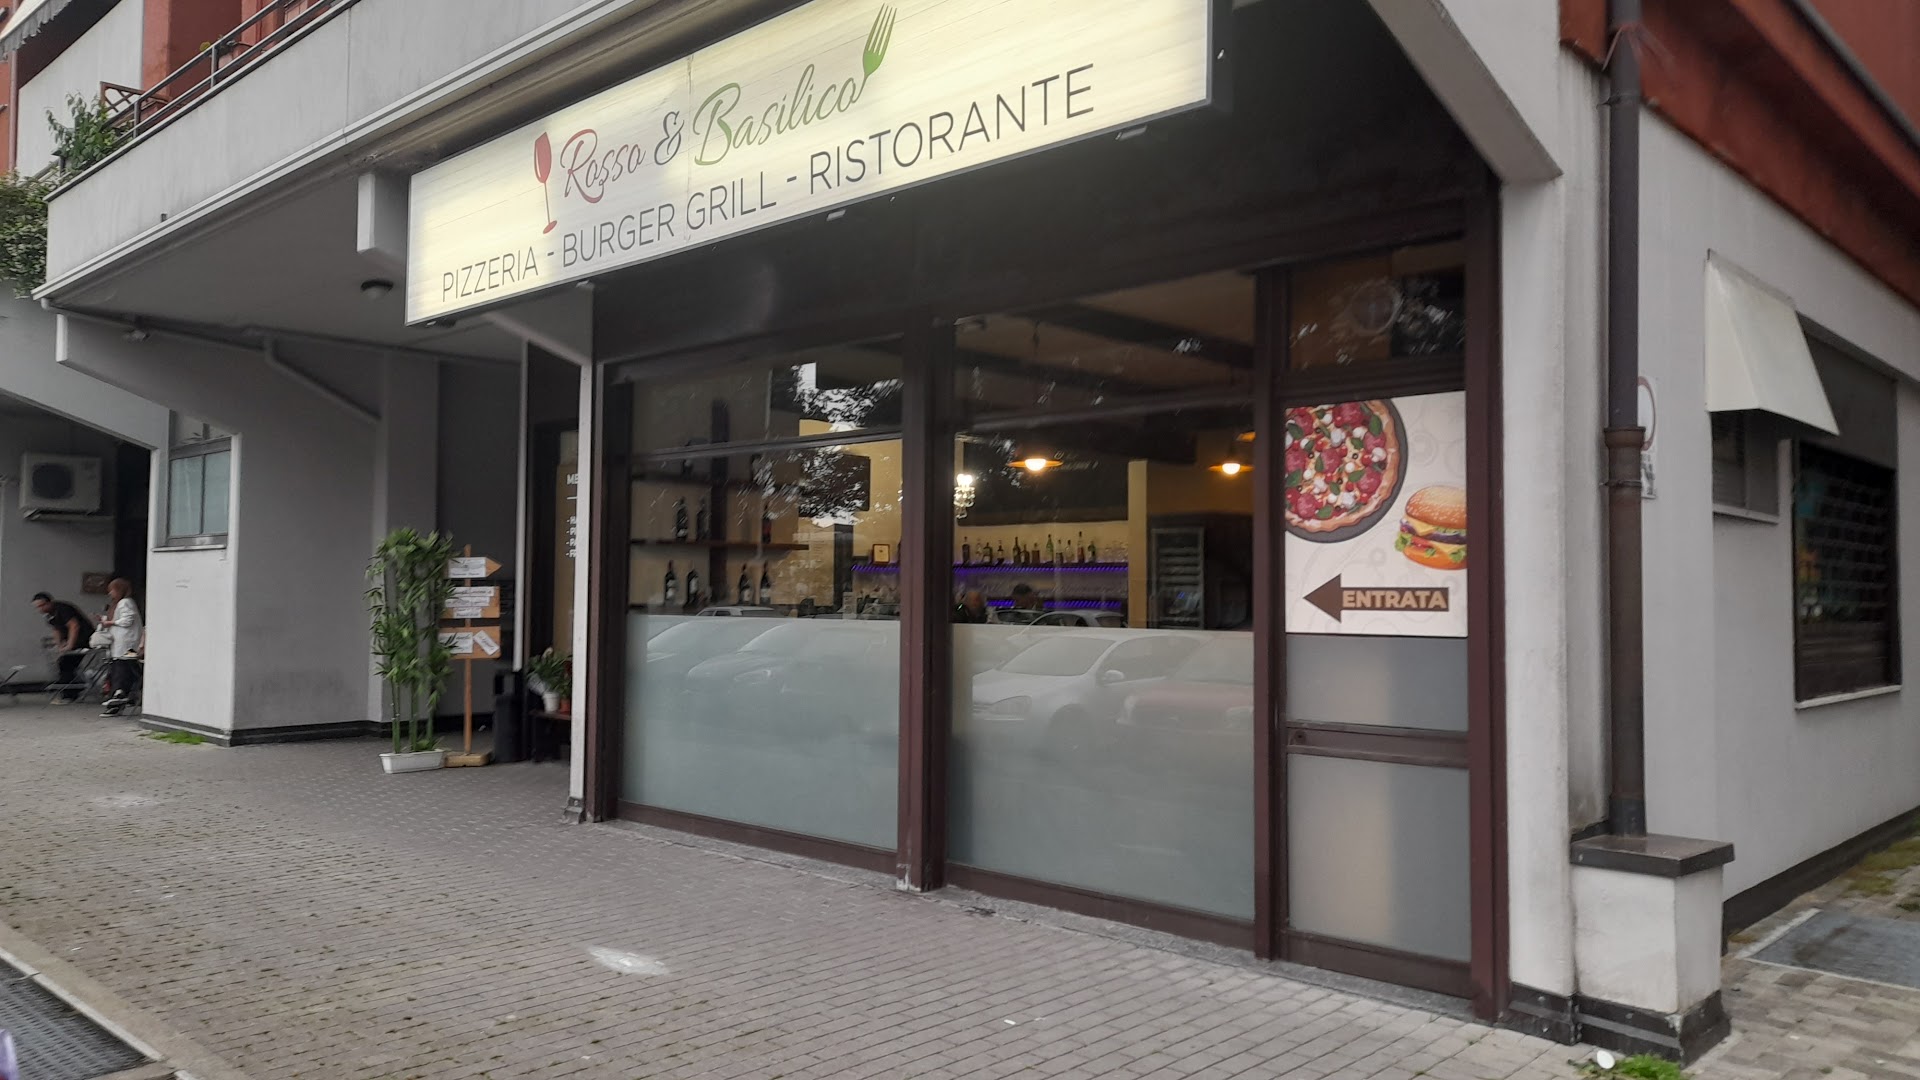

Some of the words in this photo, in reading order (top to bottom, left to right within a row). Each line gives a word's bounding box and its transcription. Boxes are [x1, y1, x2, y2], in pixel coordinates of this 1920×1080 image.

[442, 246, 539, 303] PIZZERIA
[562, 202, 675, 268] BURGER
[686, 170, 777, 231] GRILL
[809, 63, 1094, 195] RISTORANTE
[560, 128, 646, 204] Rosso
[653, 111, 685, 166] &
[693, 63, 858, 166] Basilico
[1342, 590, 1446, 609] ENTRATA
